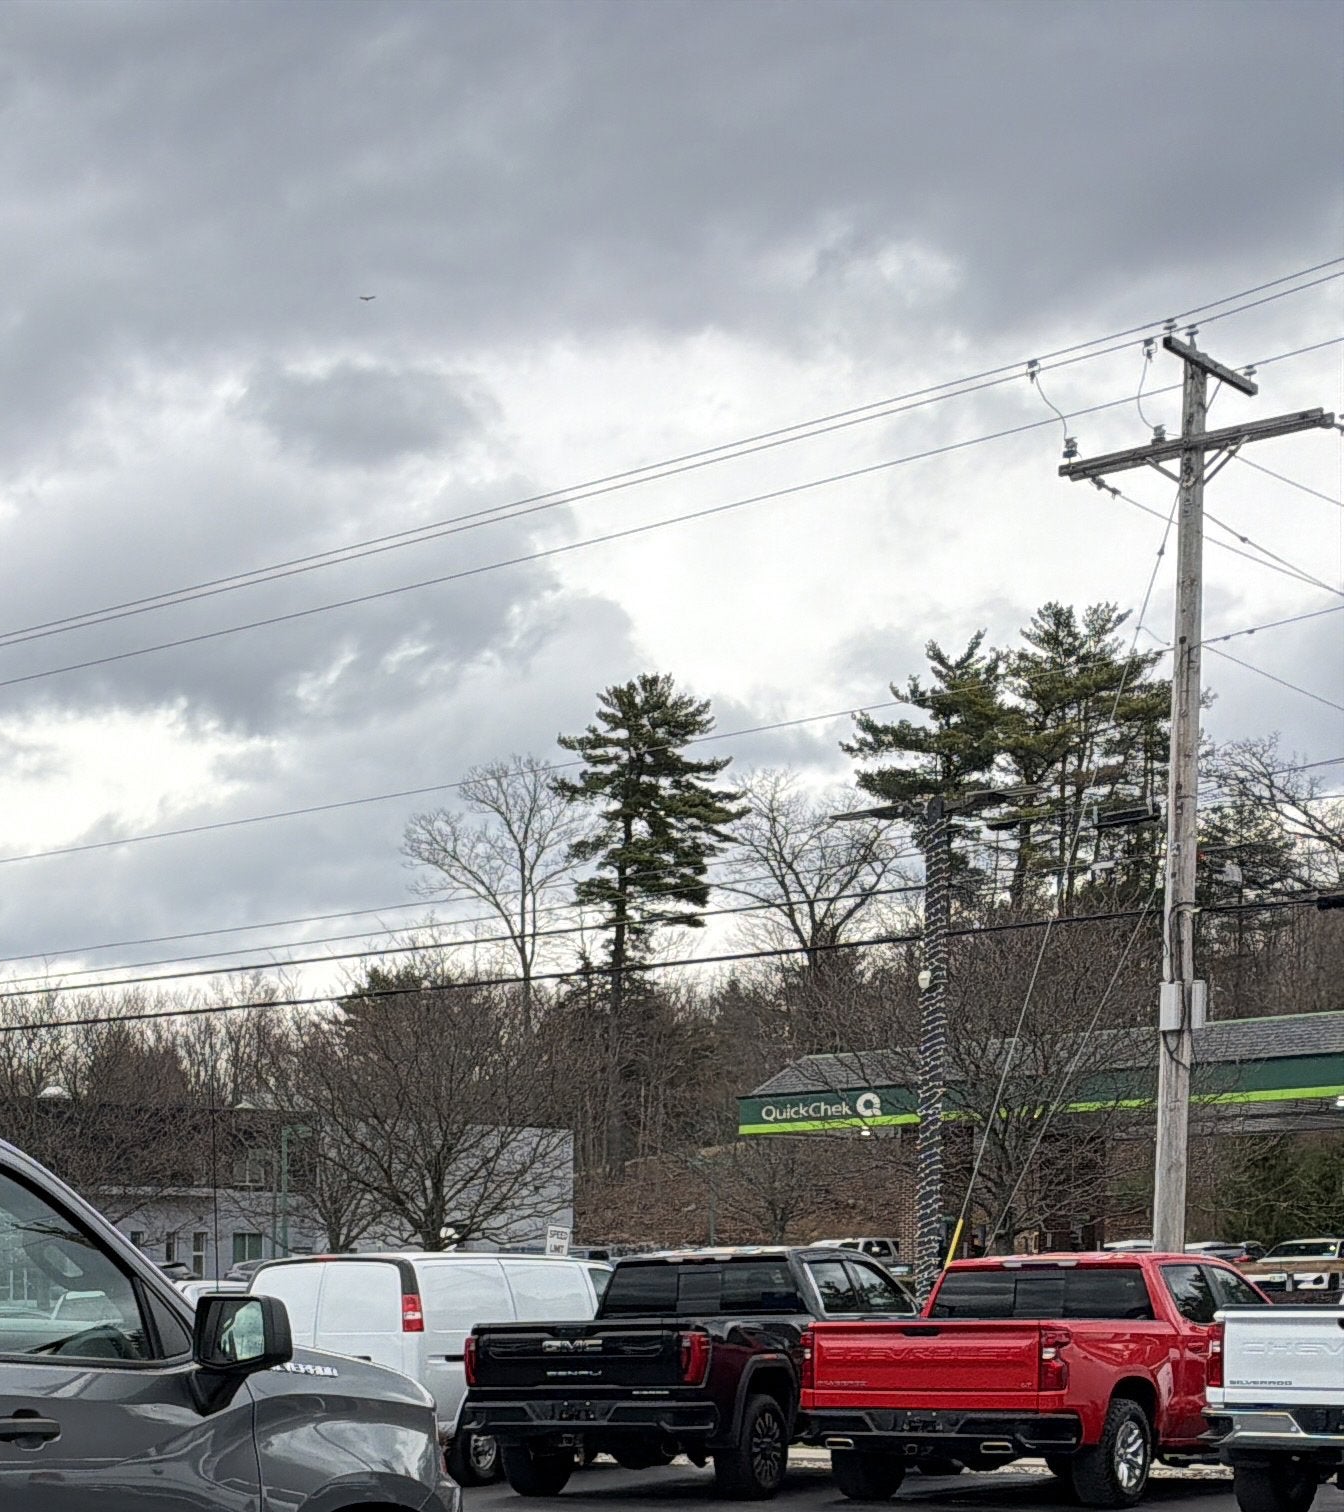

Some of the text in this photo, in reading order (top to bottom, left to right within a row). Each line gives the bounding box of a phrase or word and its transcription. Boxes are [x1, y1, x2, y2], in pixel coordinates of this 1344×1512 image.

[761, 1101, 853, 1122] QuickChek
[548, 1229, 569, 1241] SPEED
[542, 1339, 603, 1352] GMC
[1229, 1379, 1293, 1387] SILVERADO
